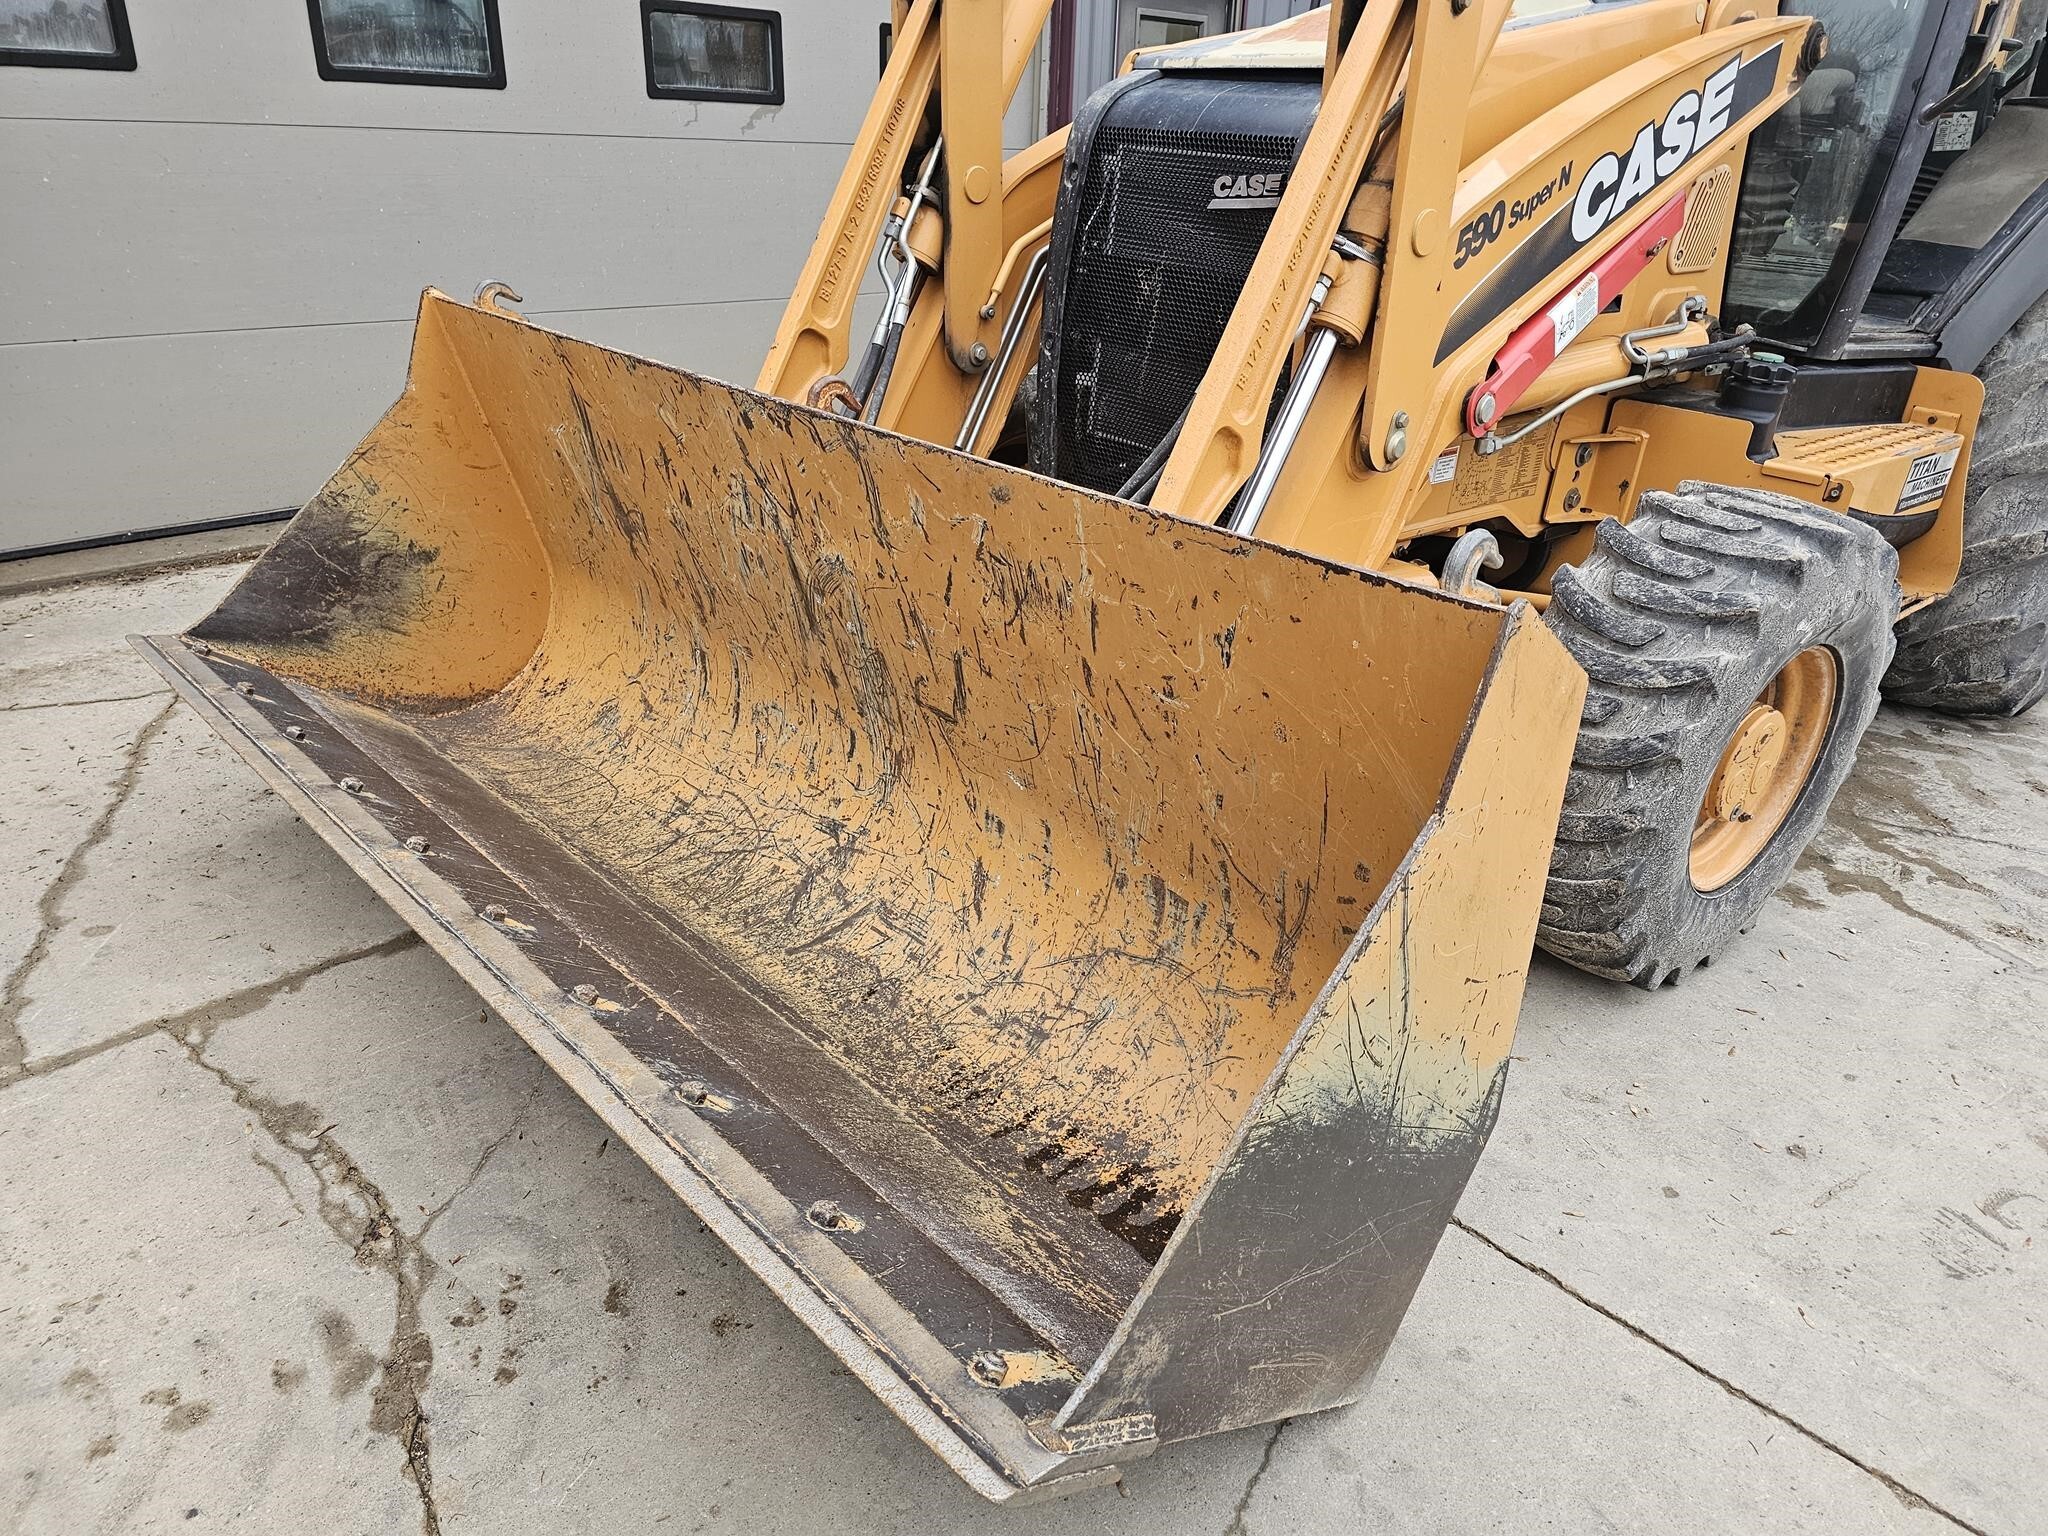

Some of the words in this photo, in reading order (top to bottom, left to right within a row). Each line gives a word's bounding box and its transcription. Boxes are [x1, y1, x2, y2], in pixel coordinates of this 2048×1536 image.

[1571, 52, 1741, 243] CASE
[1213, 173, 1283, 198] CASE
[1454, 199, 1505, 270] 590
[1508, 176, 1558, 229] Super
[1557, 159, 1574, 193] N
[1910, 456, 1941, 479] TITAN
[1910, 472, 1951, 493] MACHINERY
